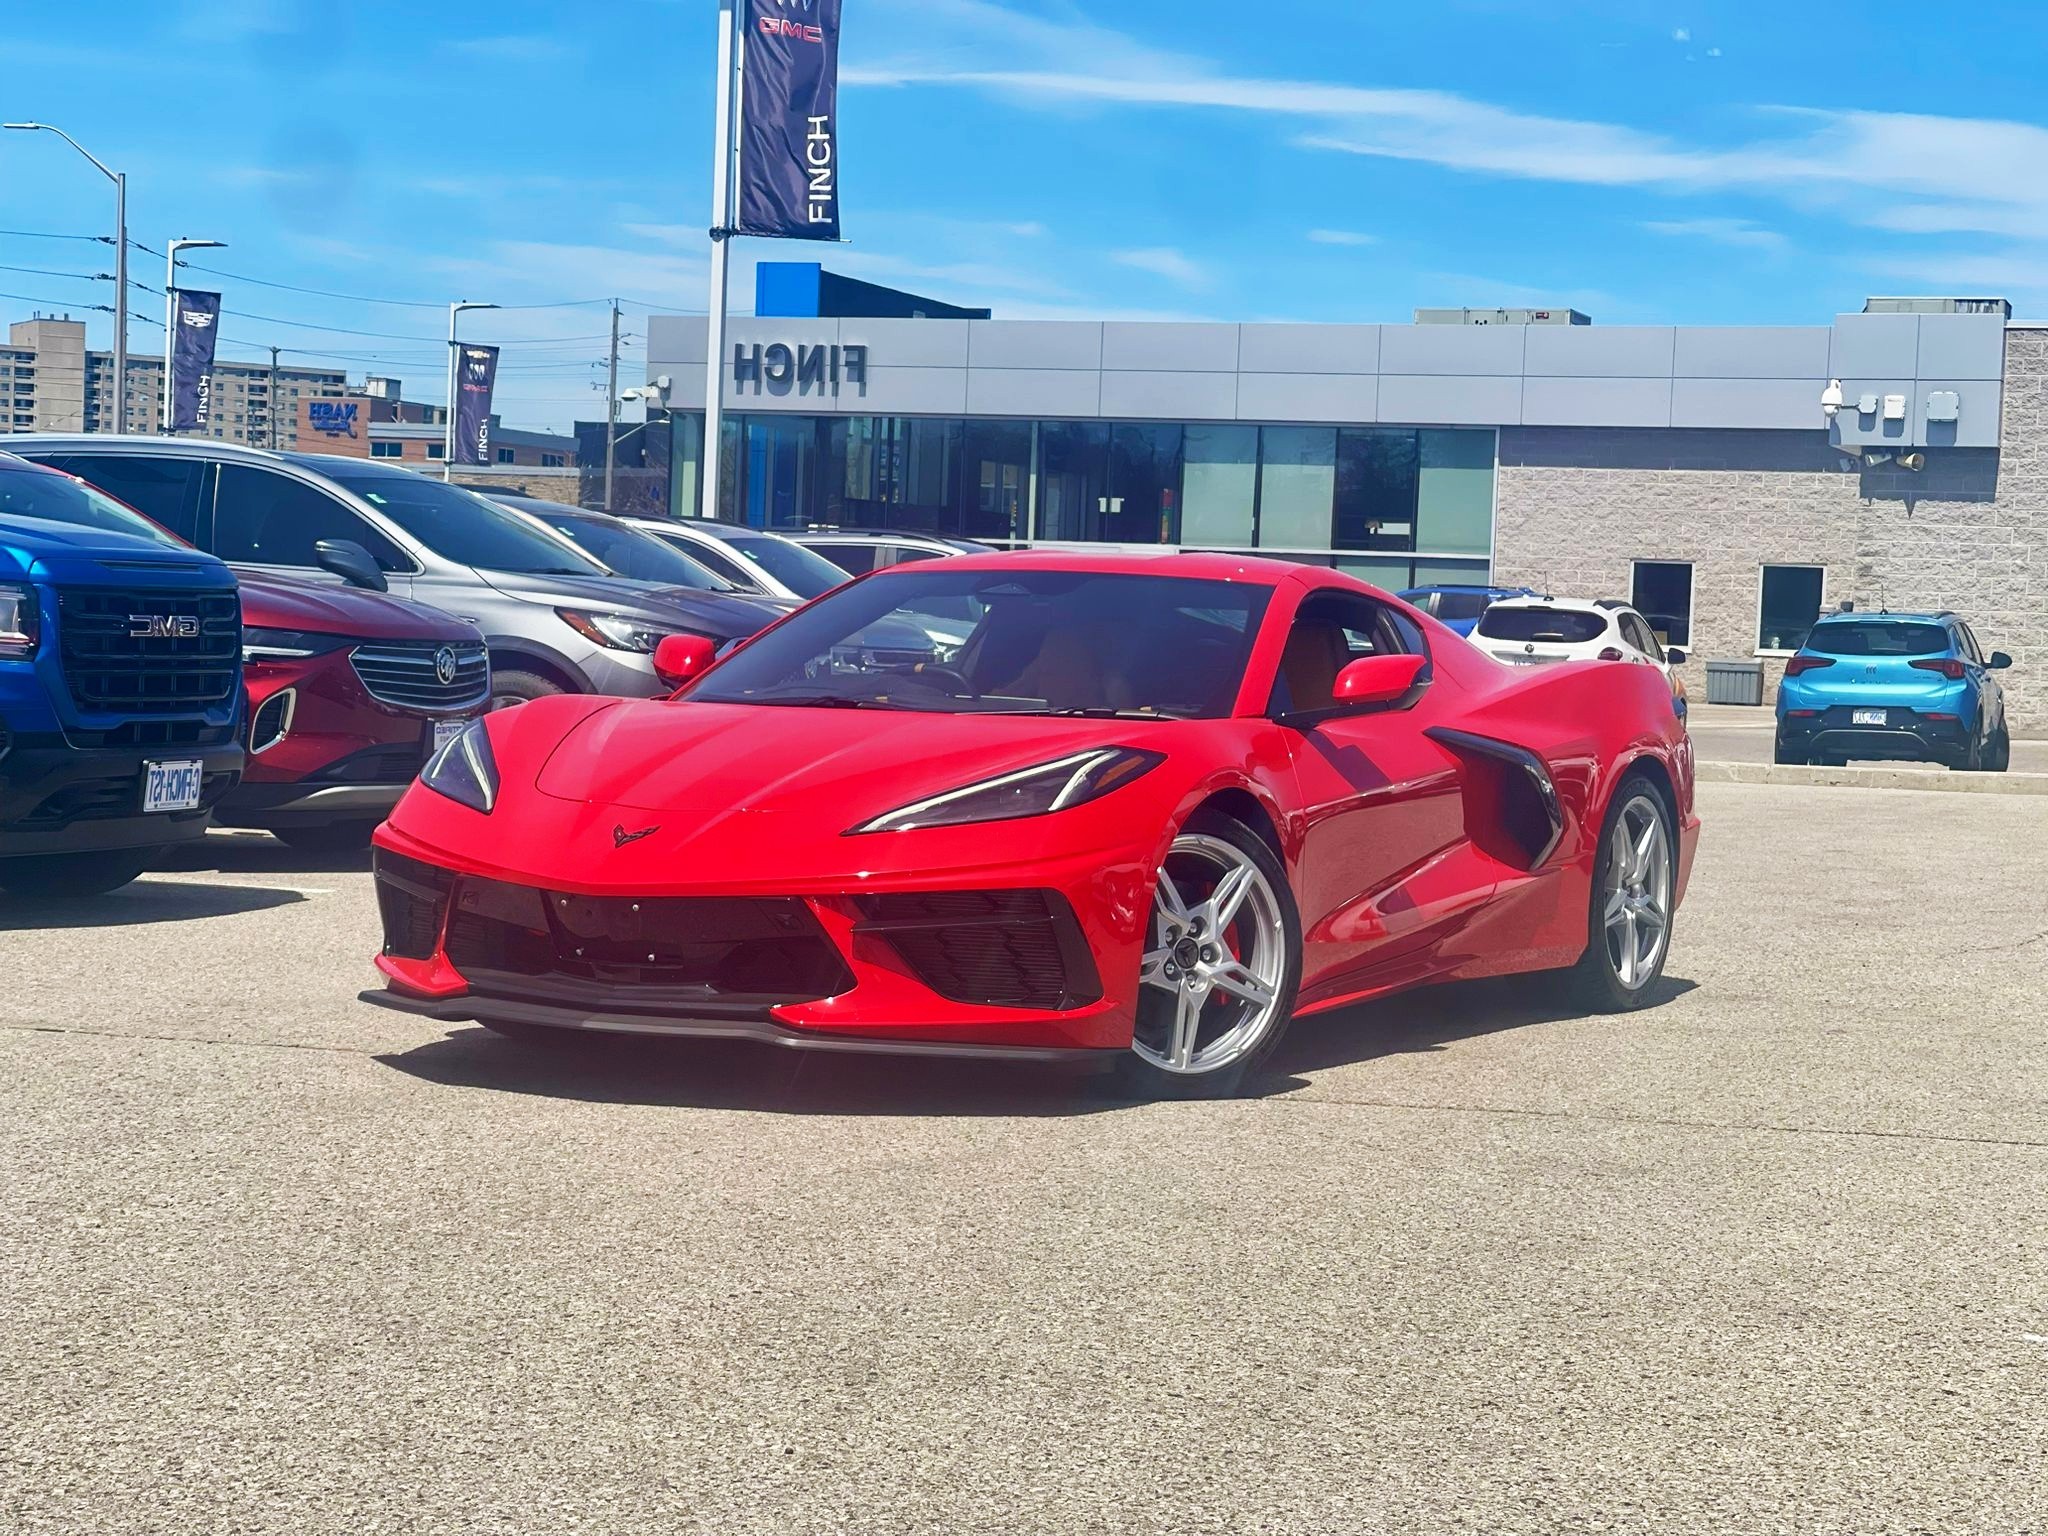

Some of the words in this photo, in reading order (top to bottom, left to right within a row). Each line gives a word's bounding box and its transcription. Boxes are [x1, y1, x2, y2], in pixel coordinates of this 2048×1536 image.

[759, 16, 823, 43] GMC
[806, 115, 833, 223] FINCH
[196, 375, 211, 423] FINCH
[478, 418, 489, 461] FINCH
